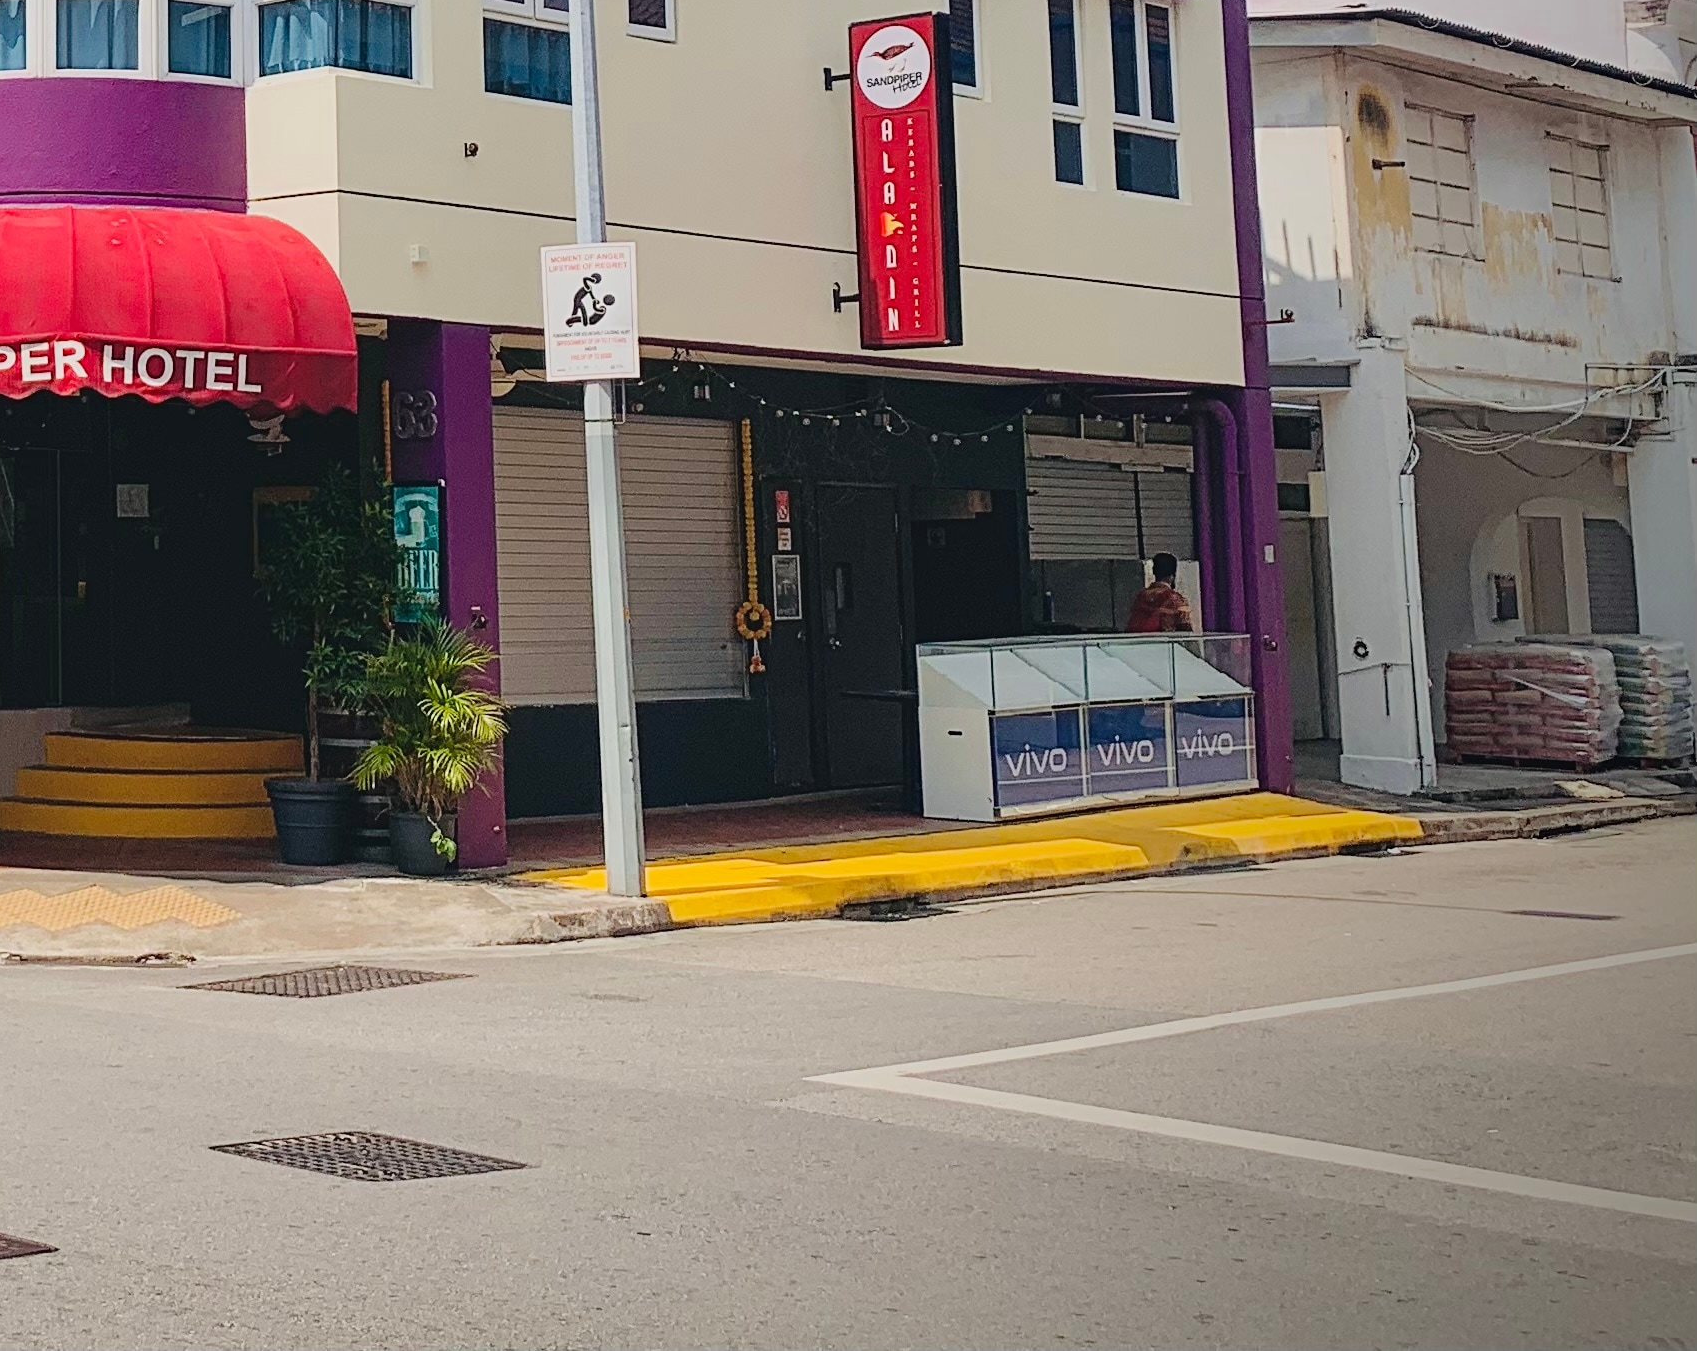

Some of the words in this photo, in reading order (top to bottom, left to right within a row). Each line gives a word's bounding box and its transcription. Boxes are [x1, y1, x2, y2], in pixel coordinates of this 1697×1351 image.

[866, 71, 923, 88] SANDPIPER
[909, 202, 919, 254] WRAPS
[548, 263, 581, 272] LIFETIME
[594, 261, 628, 269] REGRET
[550, 255, 582, 263] MOMENT
[912, 277, 922, 329] GRILL
[103, 344, 263, 393] HOTEL
[391, 390, 438, 439] 63
[1005, 743, 1067, 777] vivo
[1097, 734, 1154, 766] vivo
[1181, 728, 1233, 759] vivo
